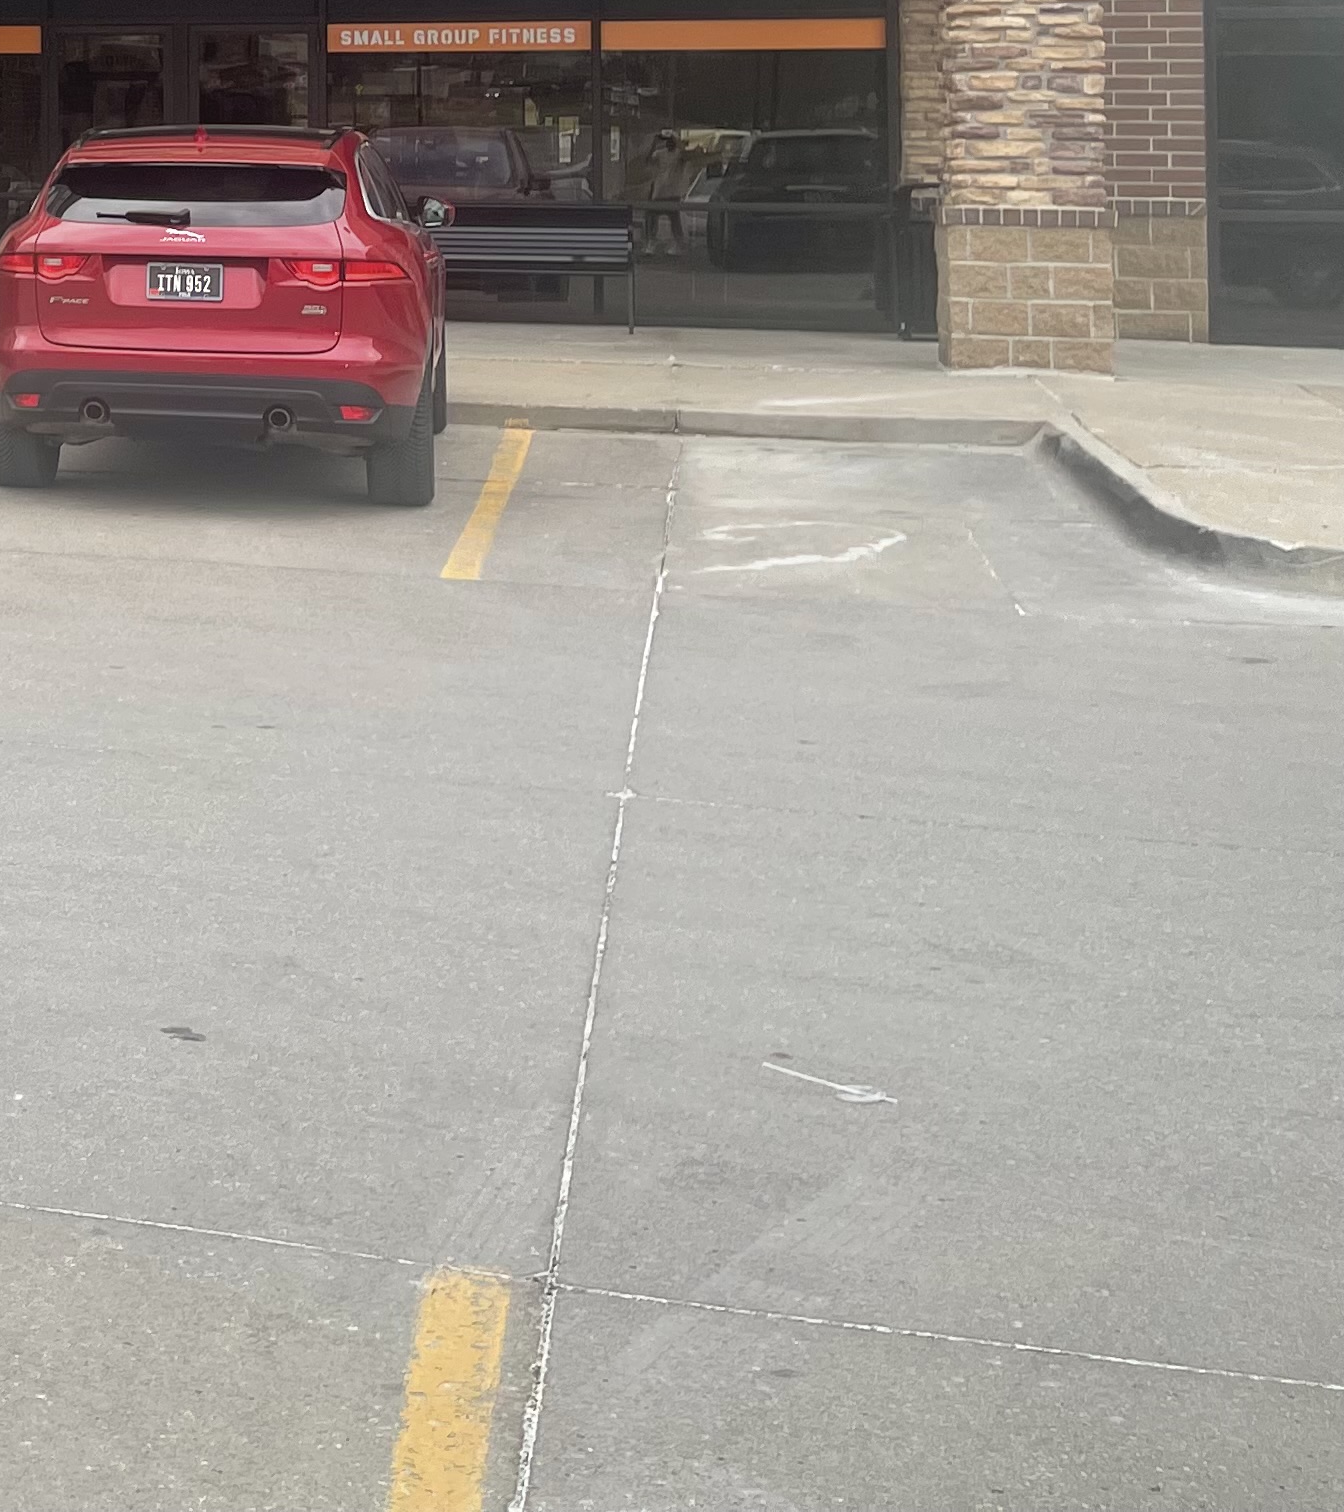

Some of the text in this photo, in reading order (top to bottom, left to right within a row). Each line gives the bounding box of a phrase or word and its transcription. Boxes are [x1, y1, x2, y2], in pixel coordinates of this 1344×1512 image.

[340, 27, 576, 46] SMALL GROUP FITNESS
[157, 274, 211, 293] ITN 952
